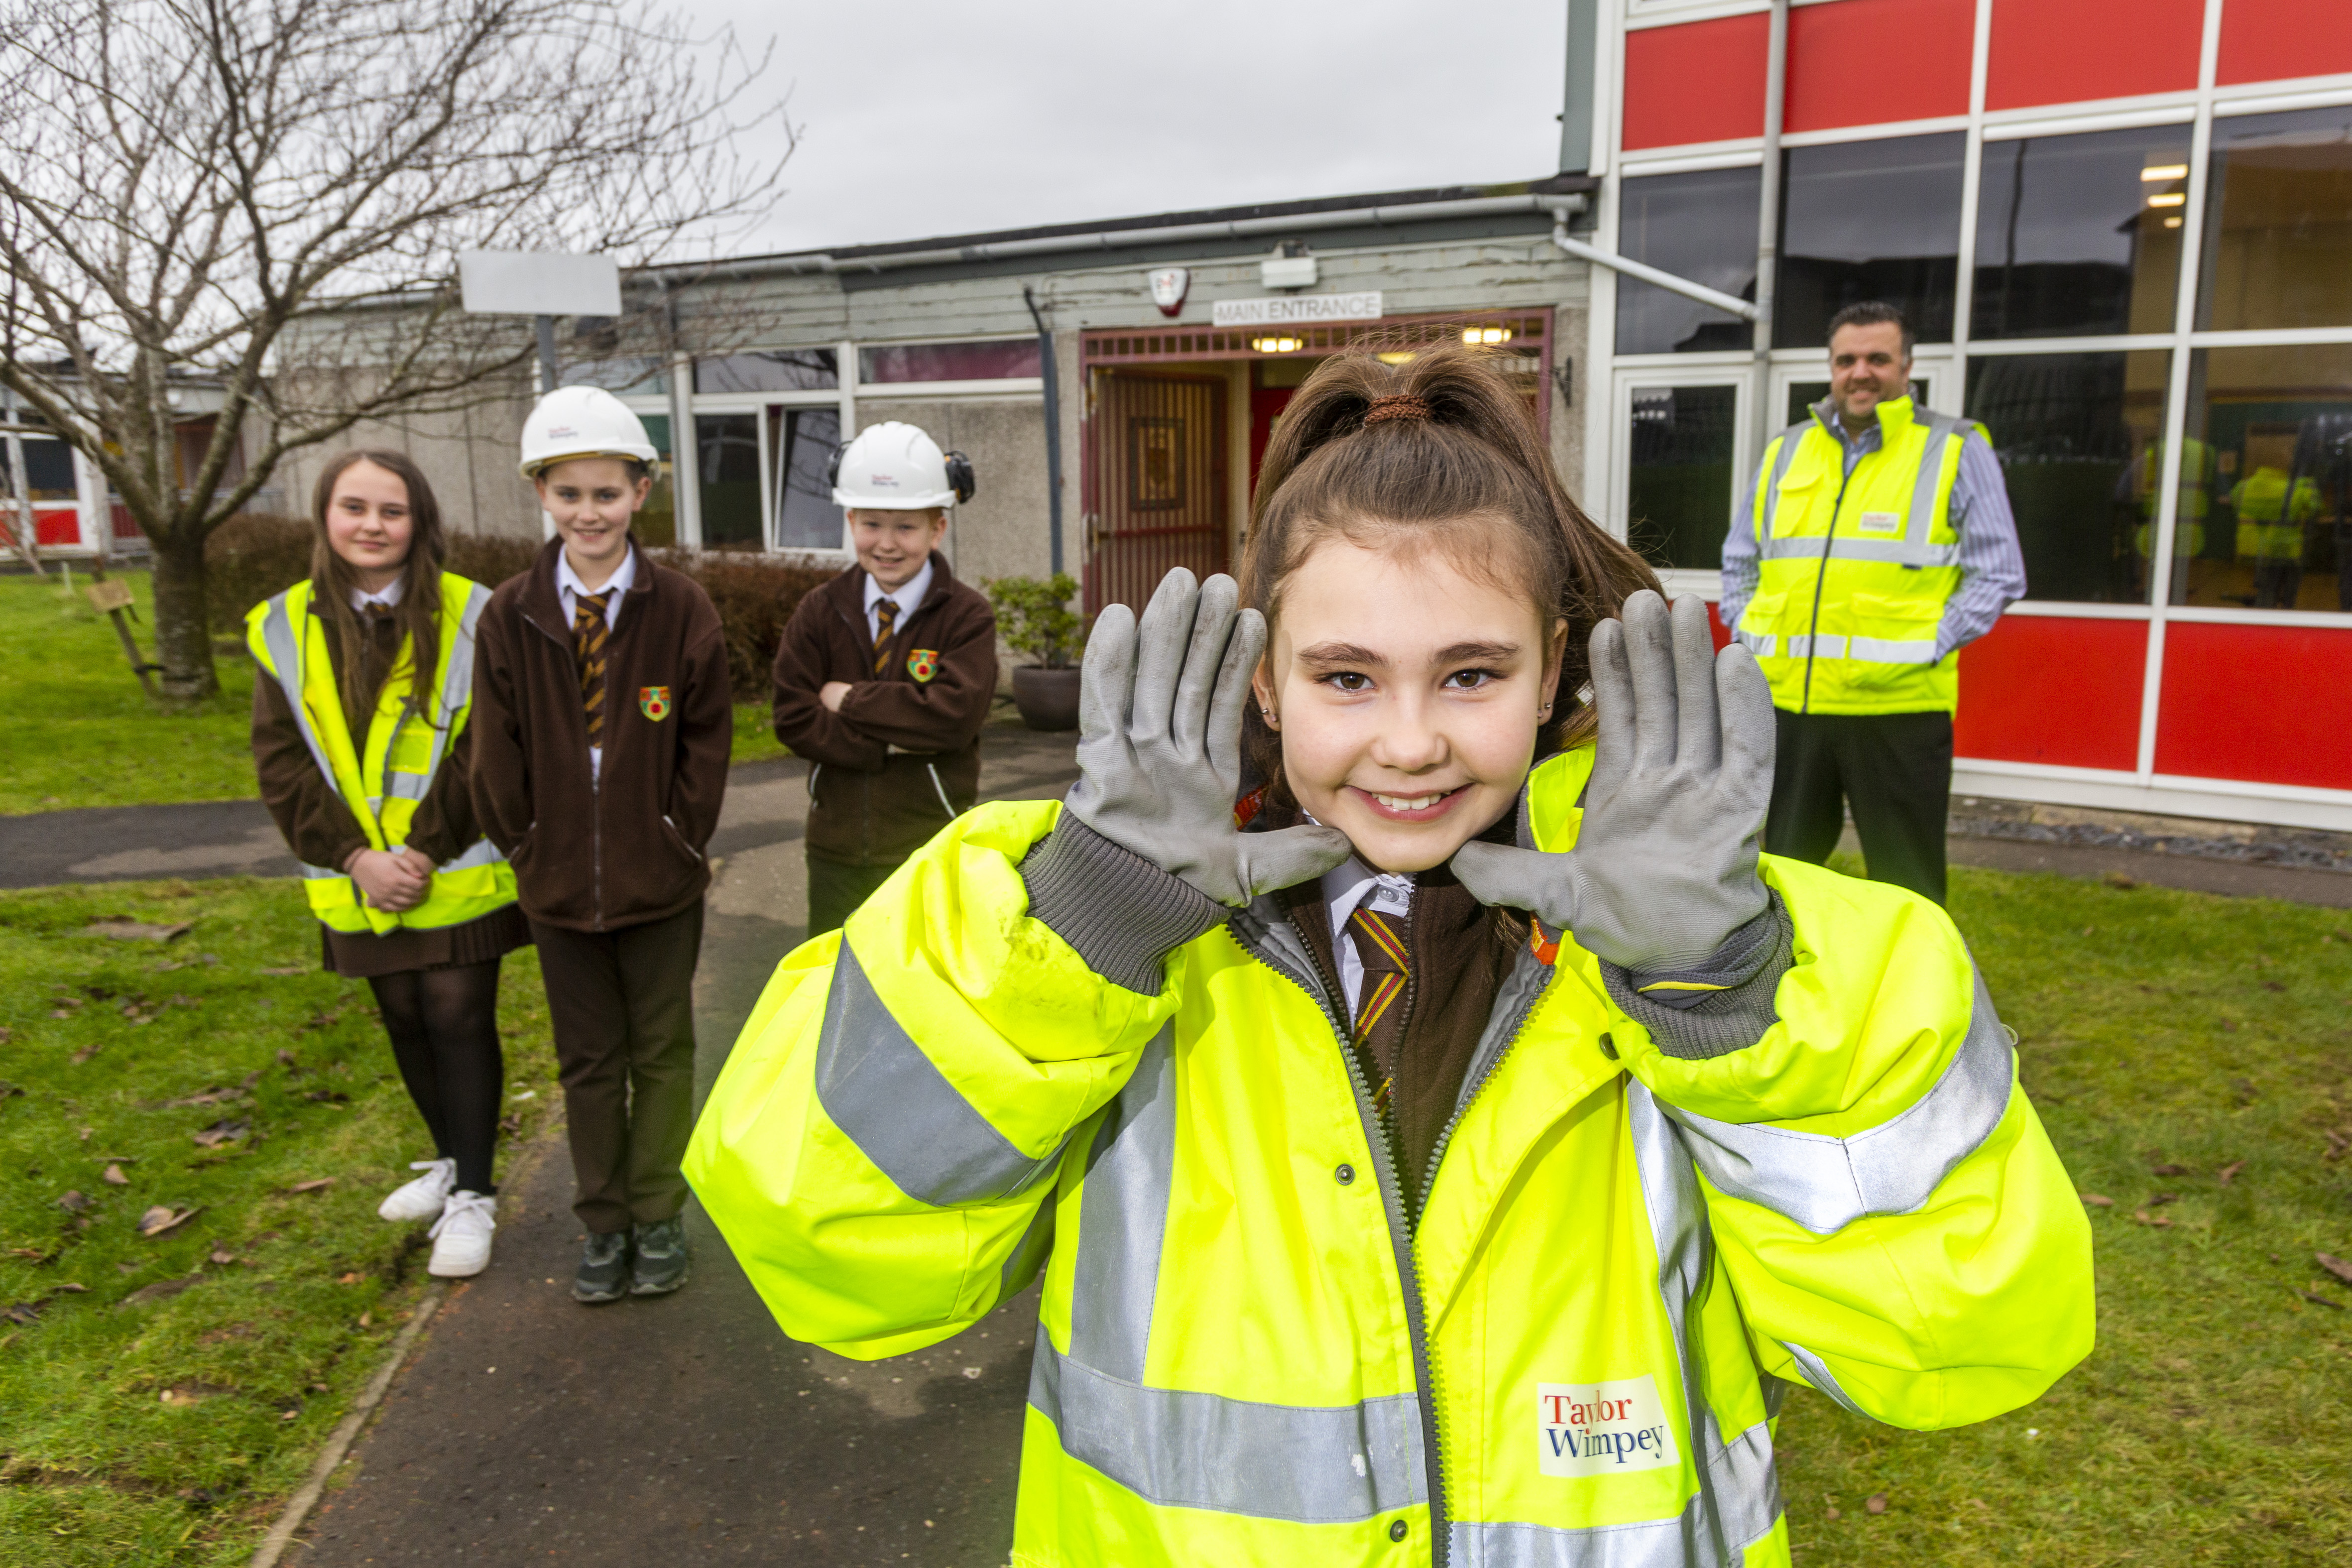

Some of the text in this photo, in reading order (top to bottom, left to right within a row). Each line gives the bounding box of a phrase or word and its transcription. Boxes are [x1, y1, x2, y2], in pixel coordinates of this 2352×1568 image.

[1217, 296, 1377, 320] MAIN ENTRANCE
[1544, 1390, 1633, 1435] Taylor
[1545, 1425, 1664, 1464] Wimpey
